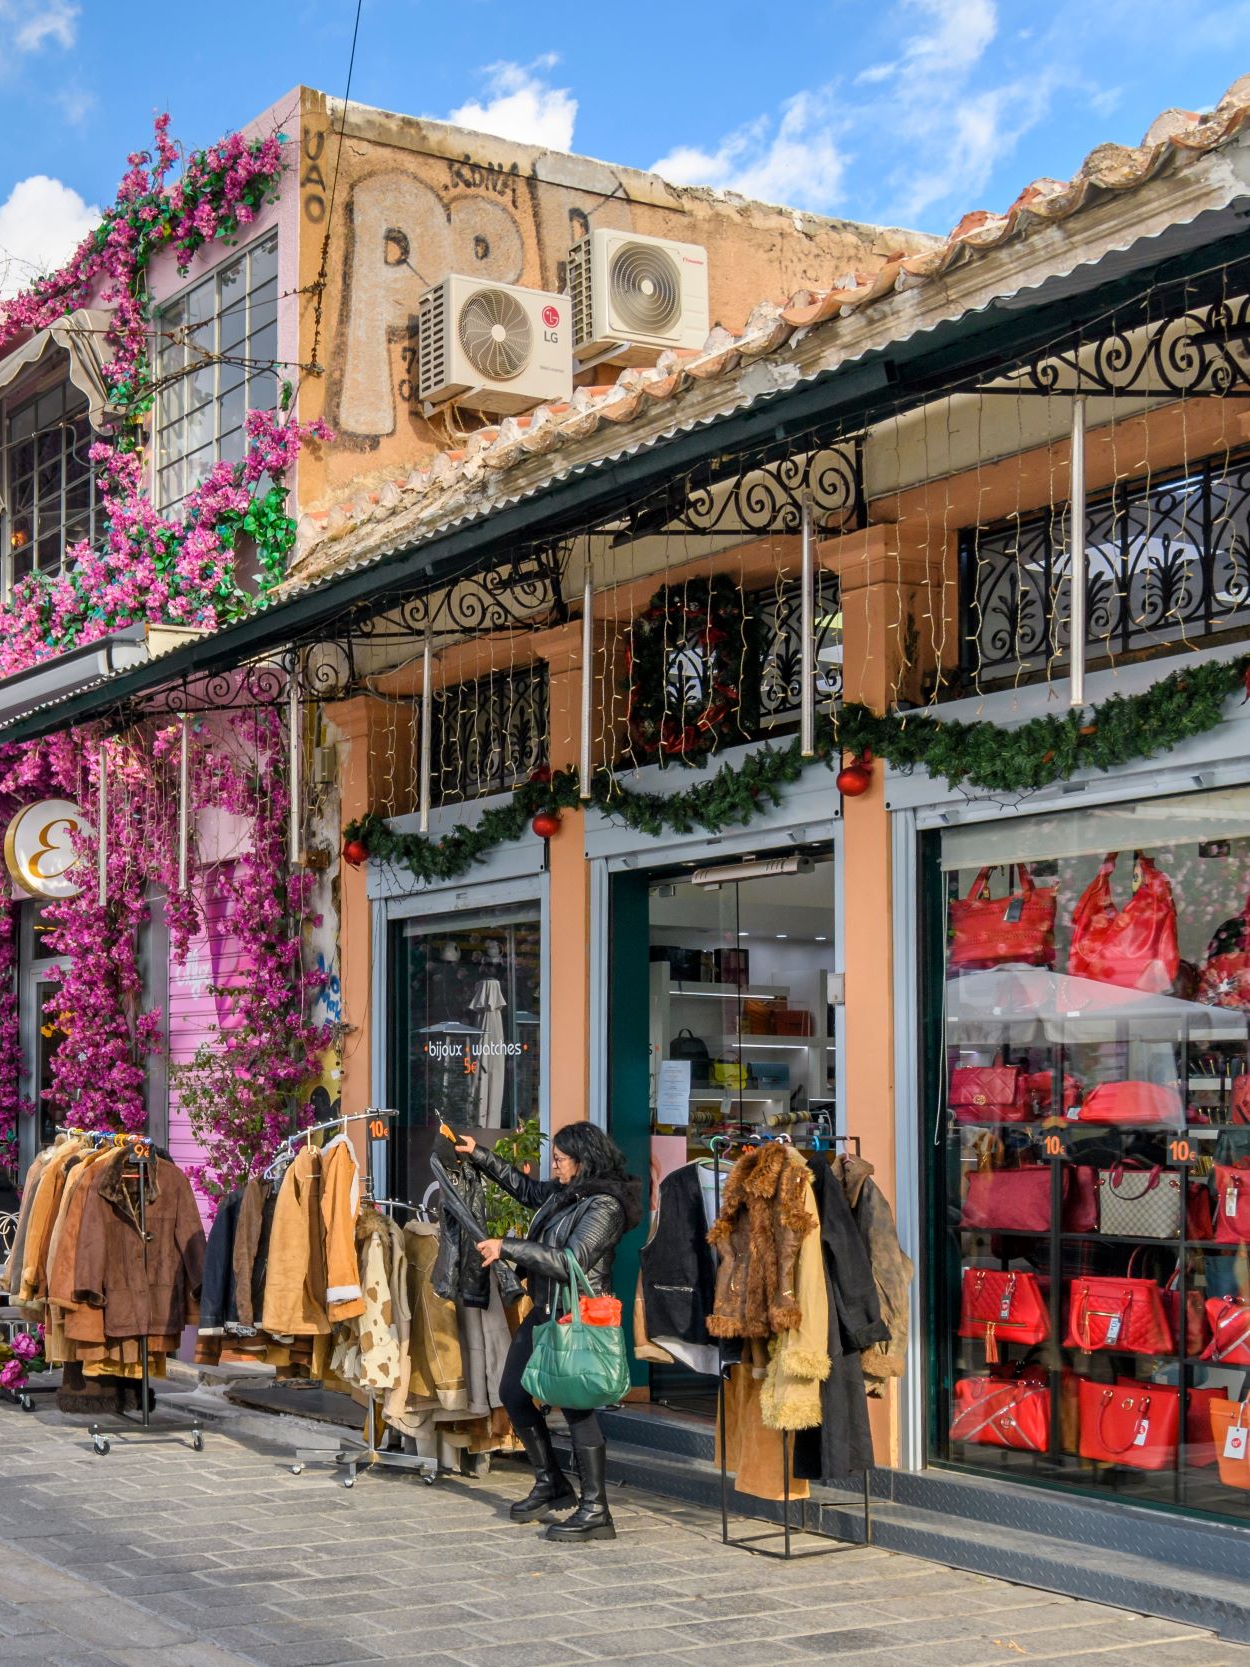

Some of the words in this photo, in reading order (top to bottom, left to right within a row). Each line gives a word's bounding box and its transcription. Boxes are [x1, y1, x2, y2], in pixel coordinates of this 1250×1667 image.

[543, 330, 559, 344] LG
[428, 1040, 463, 1061] bijoux
[472, 1039, 522, 1056] watches
[463, 1057, 478, 1075] 5€
[369, 1120, 389, 1138] 10€
[134, 1144, 150, 1158] 9€
[1044, 1135, 1066, 1156] 10€
[1169, 1140, 1197, 1162] 10€
